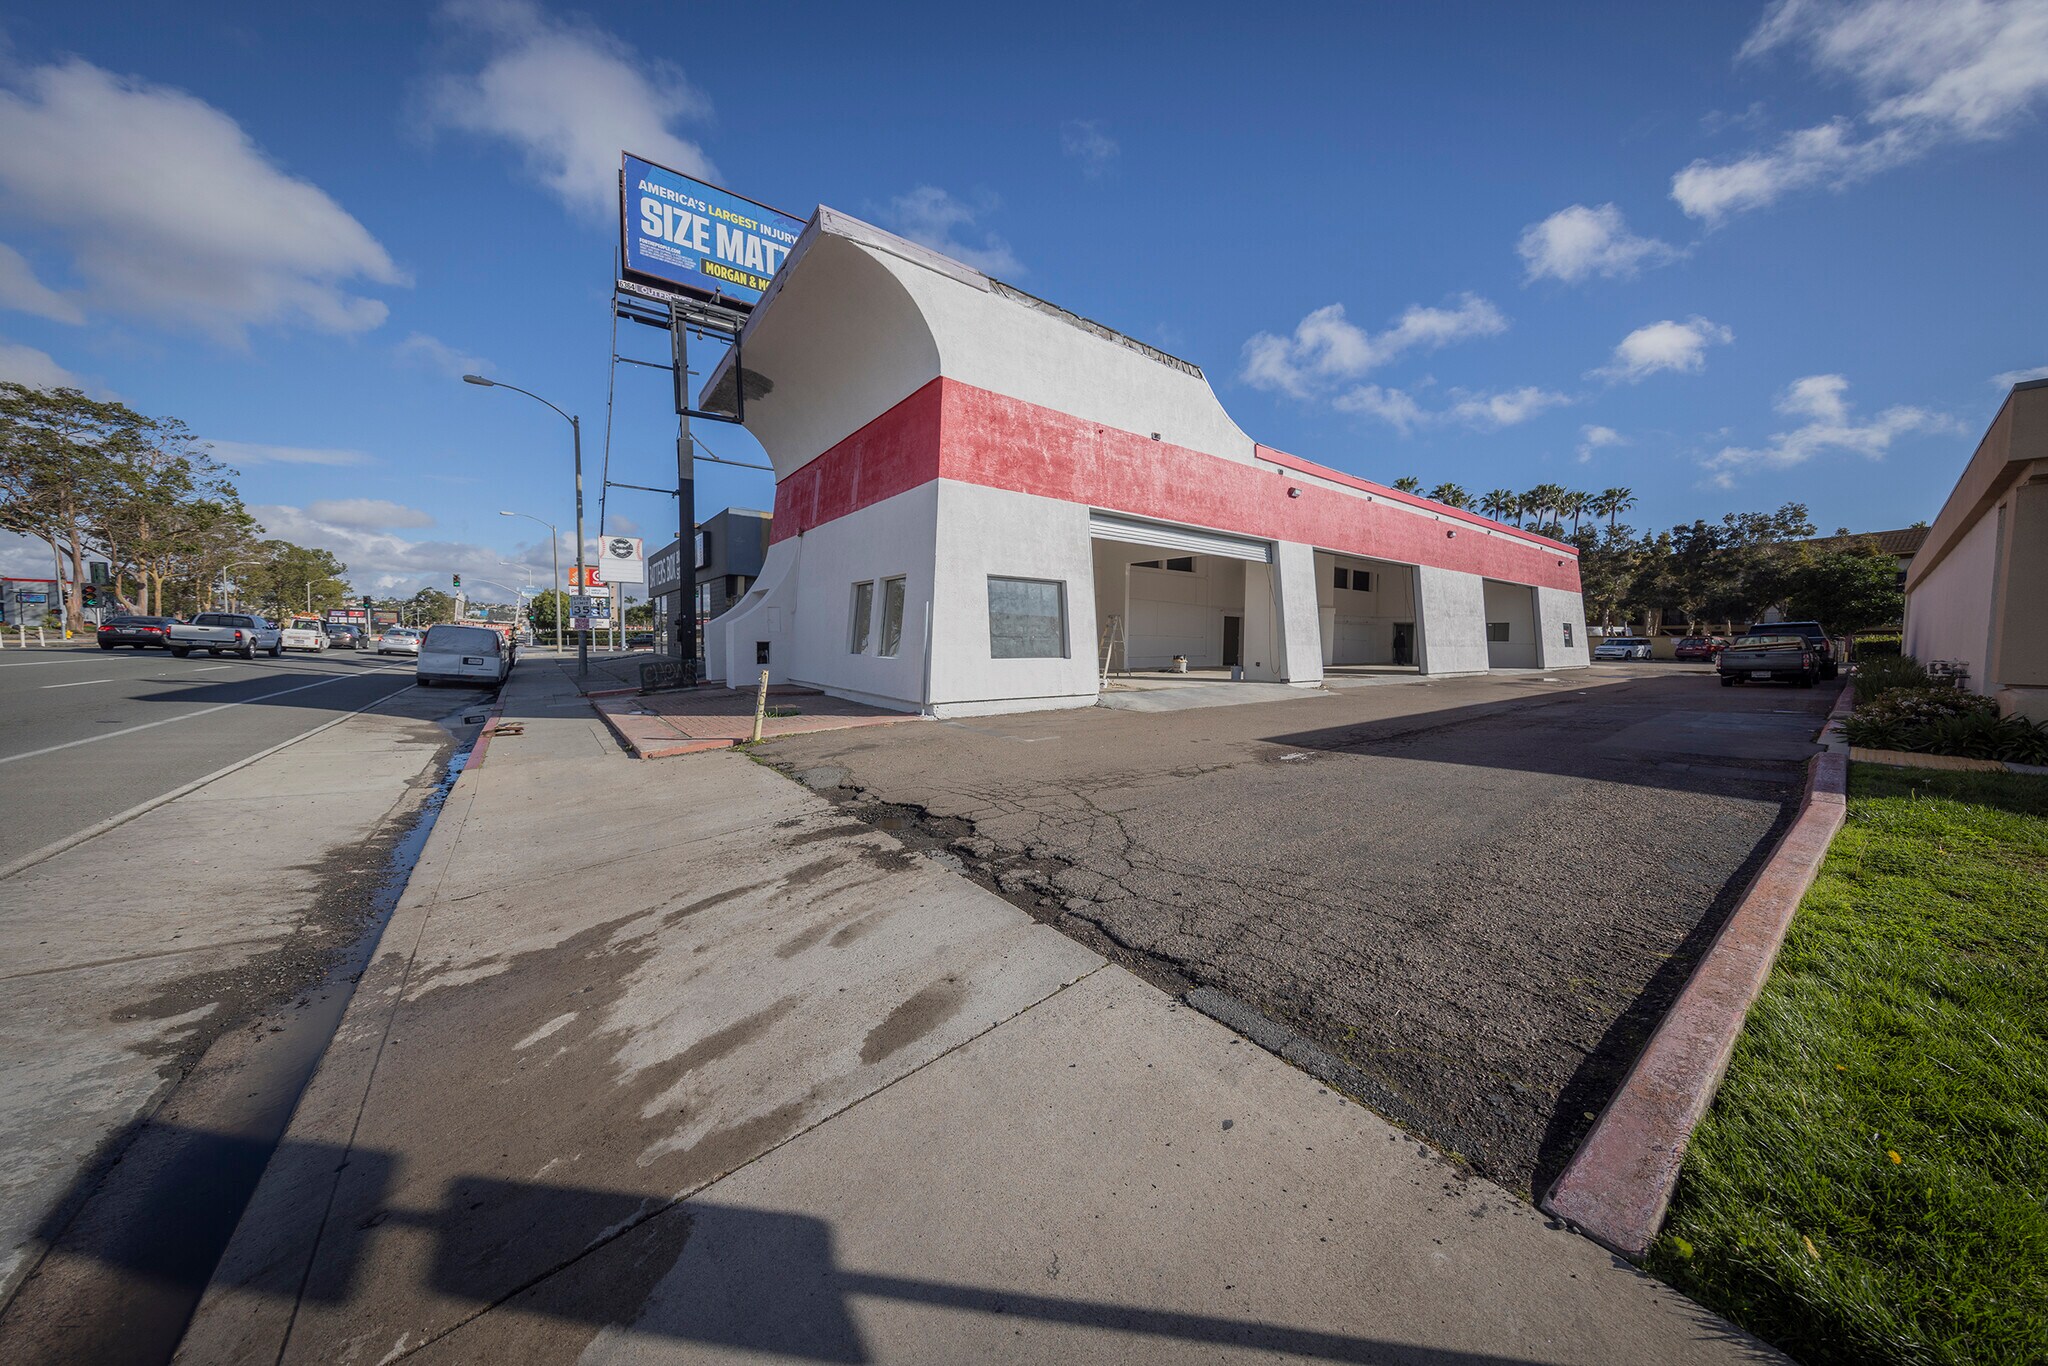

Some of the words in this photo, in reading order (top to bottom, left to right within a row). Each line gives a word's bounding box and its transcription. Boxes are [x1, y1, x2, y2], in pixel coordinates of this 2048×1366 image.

[638, 180, 706, 212] AMERICA'S
[708, 204, 758, 231] LARGEST
[760, 223, 799, 244] INJURY
[640, 197, 710, 254] SIZE
[705, 261, 747, 285] MORGAN
[749, 275, 757, 289] &
[574, 605, 590, 614] 35
